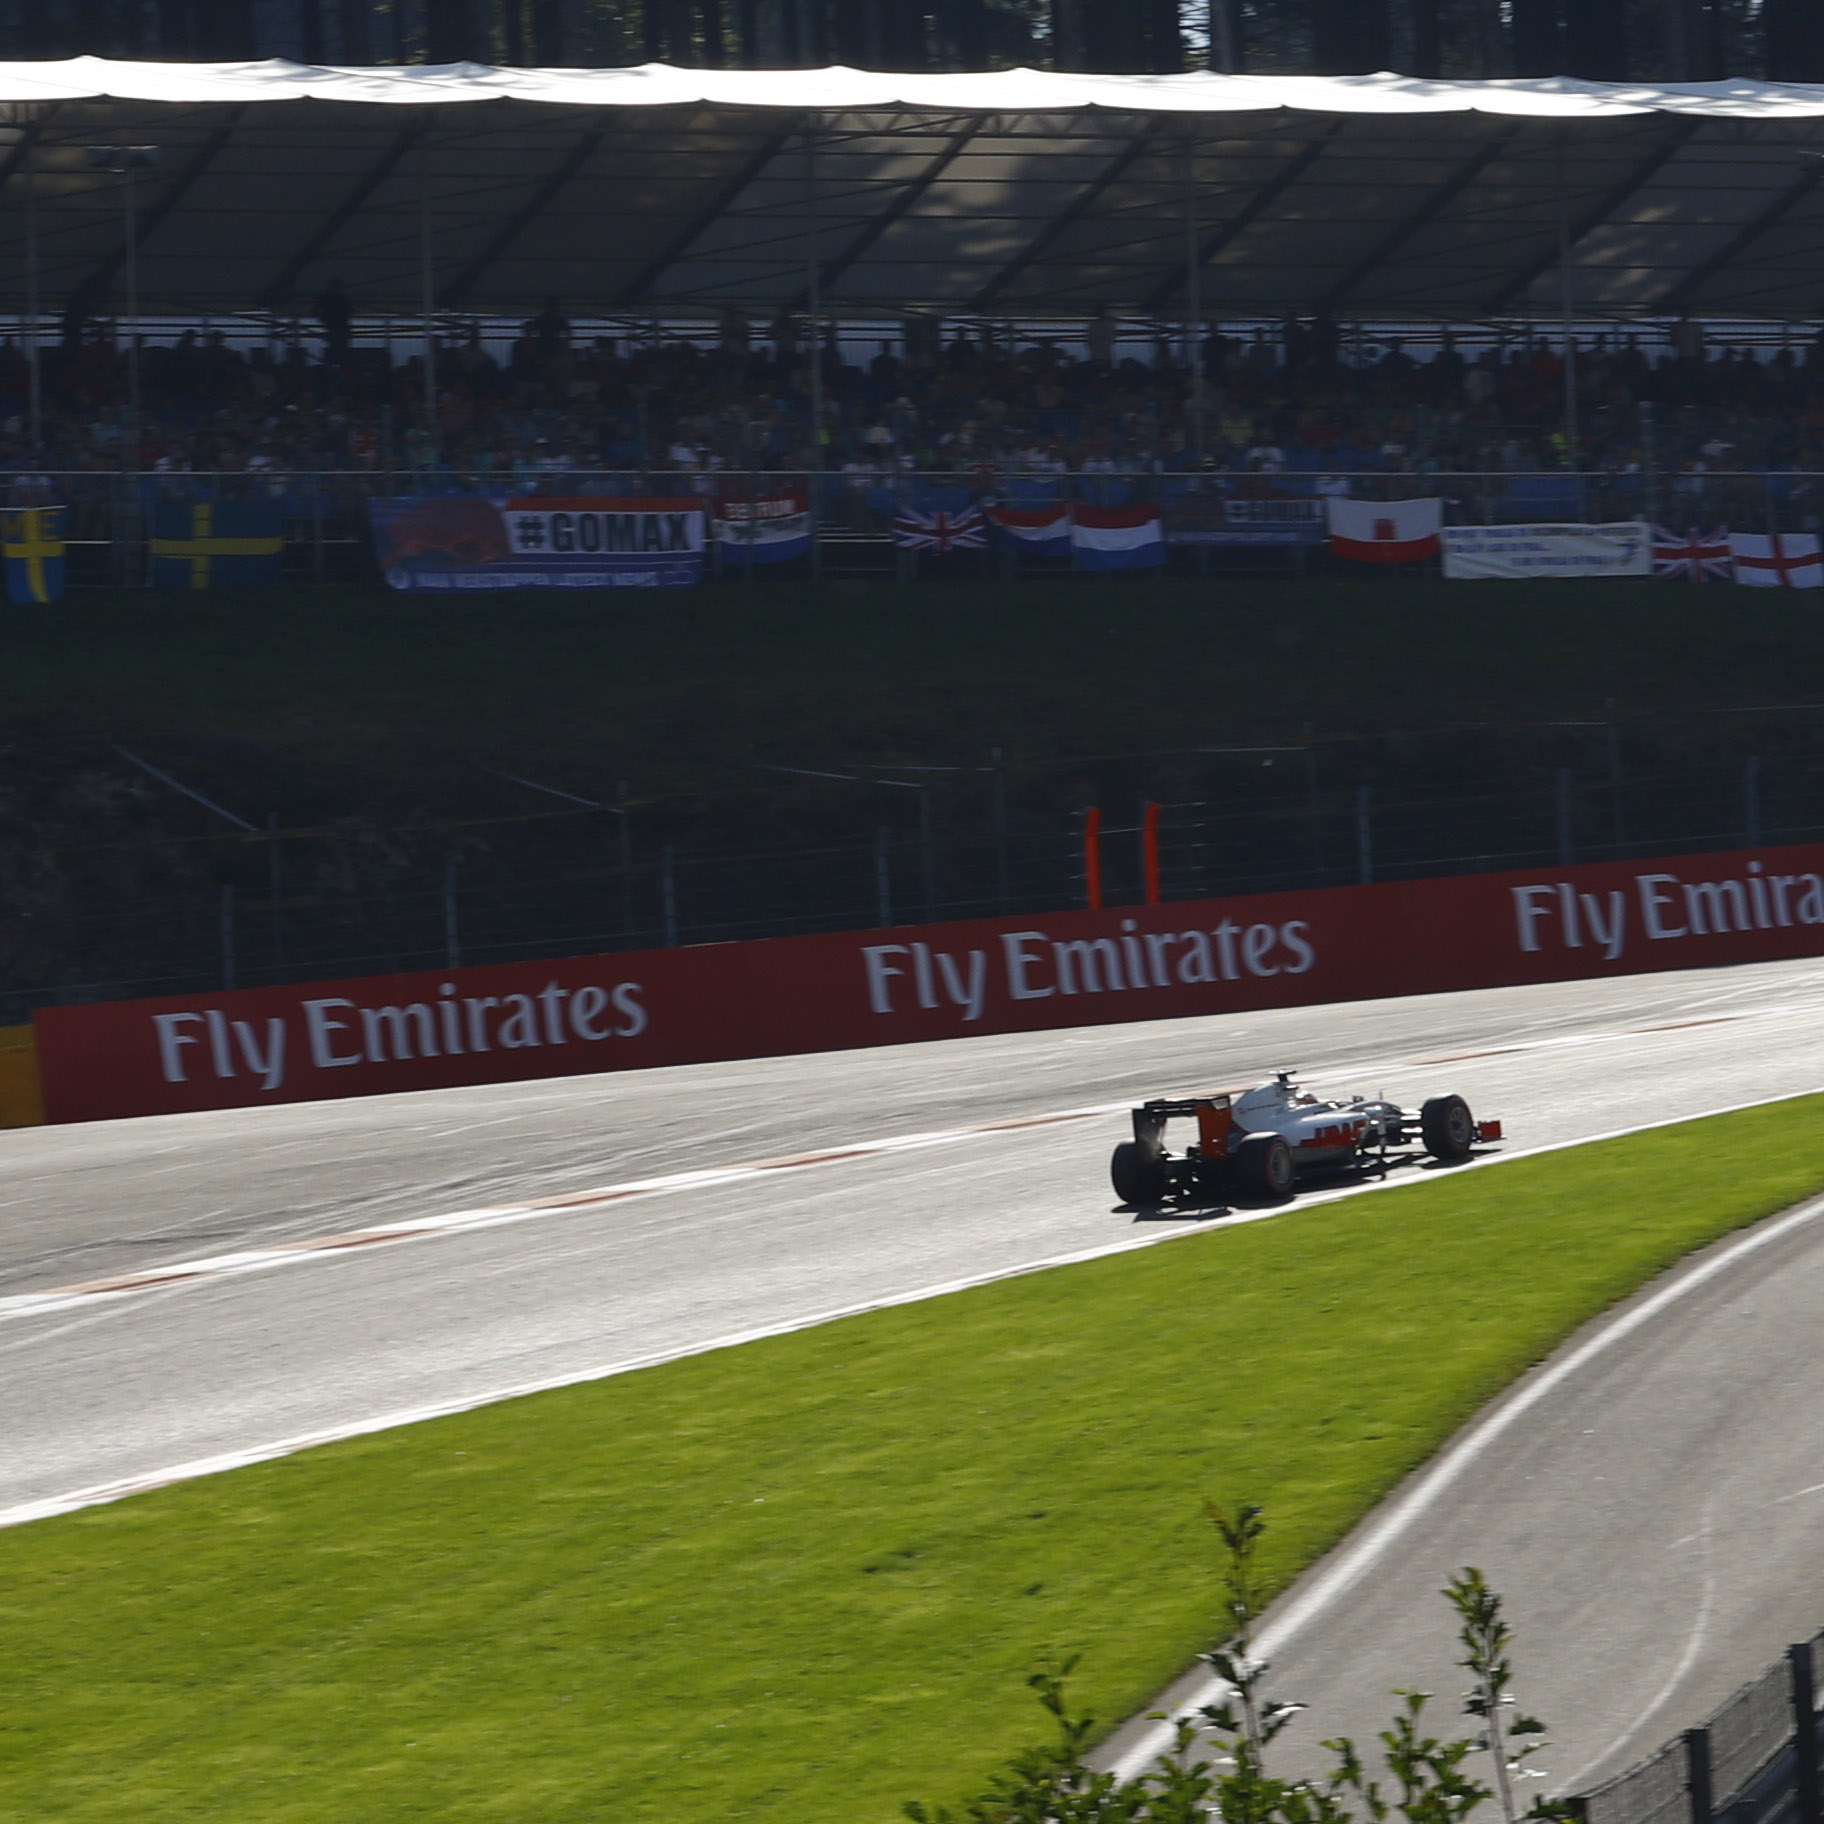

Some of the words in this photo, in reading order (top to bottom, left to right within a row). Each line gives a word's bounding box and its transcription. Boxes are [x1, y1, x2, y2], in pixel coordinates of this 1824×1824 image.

[517, 511, 688, 553] #GOMAX
[1511, 882, 1625, 960] Fly
[861, 941, 987, 1021] Fly
[1000, 918, 1316, 1000] Emirates
[152, 1009, 286, 1090] Fly
[302, 982, 648, 1068] Emirates
